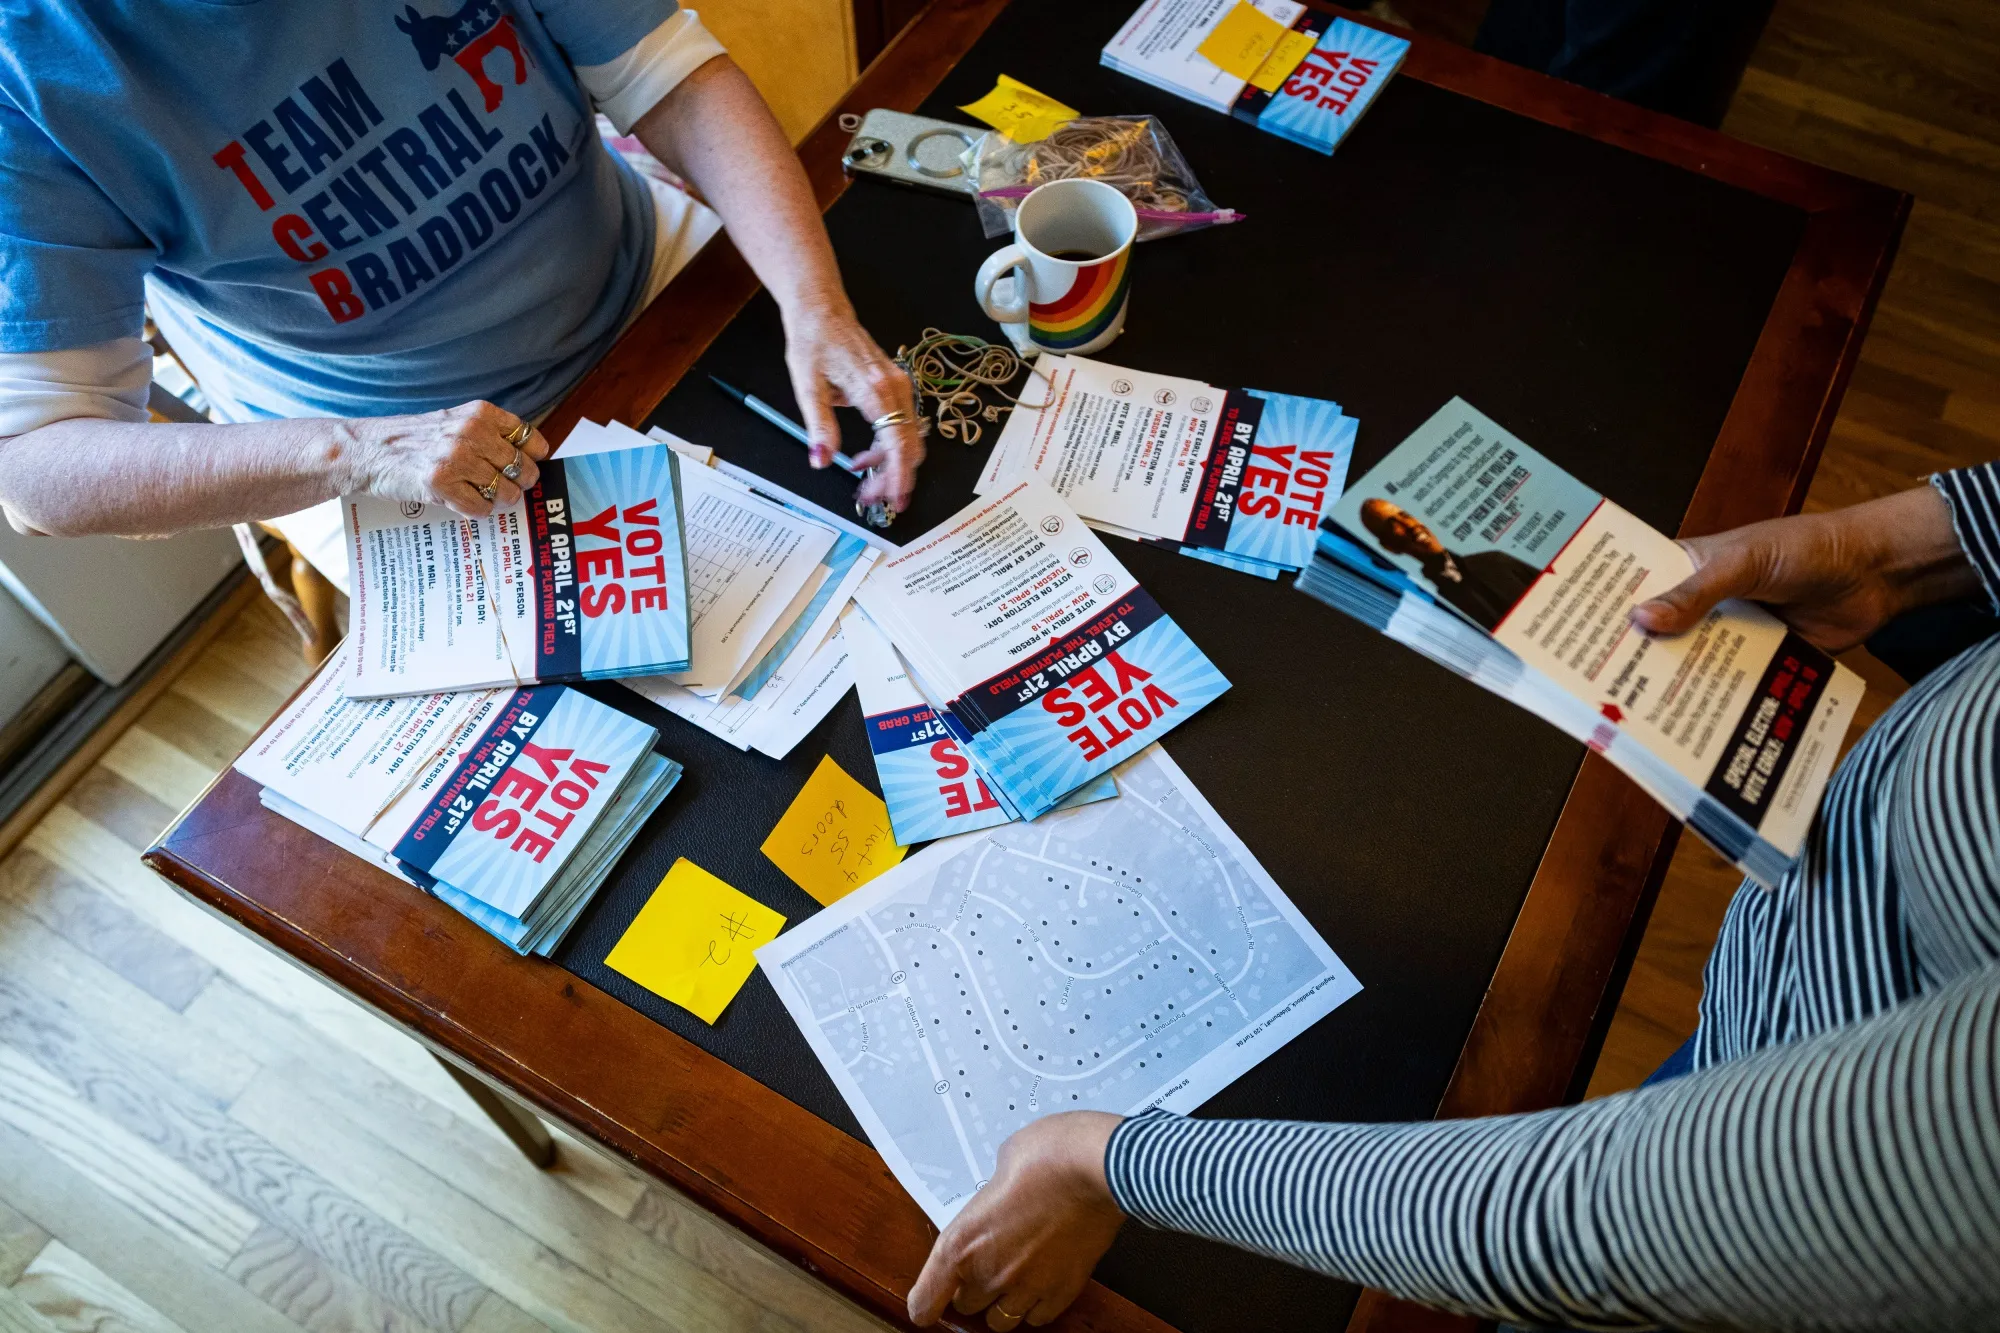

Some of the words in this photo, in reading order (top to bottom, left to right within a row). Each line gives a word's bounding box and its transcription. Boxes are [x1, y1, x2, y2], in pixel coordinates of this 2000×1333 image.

[1283, 48, 1349, 102] YES
[1316, 58, 1379, 116] VOTE
[212, 57, 385, 212] TEAM
[272, 88, 504, 263] CENTRAL
[308, 113, 570, 324] BRADDOCK
[1227, 408, 1238, 418] TO
[1196, 420, 1207, 435] VOTE
[1219, 420, 1235, 446] LEVEL
[1232, 422, 1252, 444] BY
[1190, 438, 1202, 457] EARLY
[1214, 449, 1227, 465] THE
[1220, 446, 1246, 487] APRIL
[532, 482, 542, 498] TO
[1179, 467, 1192, 494] PERSON:
[1202, 467, 1220, 502] PLAYING
[1236, 445, 1296, 518] YES
[1282, 451, 1333, 530] VOTE
[545, 497, 565, 525] BY
[1194, 505, 1209, 529] FIELD
[1213, 492, 1233, 521] 21ST
[470, 518, 479, 539] VOTE
[498, 513, 507, 533] NOW
[508, 511, 518, 535] VOTE
[533, 501, 547, 539] LEVEL
[422, 523, 431, 546] VOTE
[460, 519, 470, 561] TUESDAY,
[425, 549, 433, 561] BY
[502, 545, 510, 571] APRIL
[511, 538, 521, 565] EARLY
[539, 541, 550, 566] THE
[571, 504, 625, 618] YES
[622, 498, 667, 614] VOTE
[1014, 555, 1024, 564] BY
[1024, 541, 1045, 557] VOTE
[514, 569, 522, 578] IN
[550, 532, 572, 593] APRIL
[990, 562, 1013, 578] MAIL:
[427, 565, 435, 589] MAIL:
[464, 564, 473, 589] APRIL
[504, 574, 512, 584] 18
[1029, 565, 1066, 591] TUESDAY,
[1051, 573, 1072, 588] VOTE
[466, 593, 473, 602] 21
[515, 581, 524, 618] PERSON:
[541, 569, 553, 621] PLAYING
[1007, 588, 1030, 605] APRIL
[1039, 585, 1052, 595] ON
[1071, 591, 1089, 605] NOW
[556, 598, 575, 634] 21ST
[997, 602, 1007, 612] 21
[1003, 593, 1040, 619] ELECTION
[1040, 608, 1064, 625] APRIL
[1074, 598, 1096, 614] VOTE
[1116, 602, 1134, 616] TO
[983, 616, 1003, 629] DAY:
[1030, 622, 1041, 631] 18
[1040, 627, 1050, 636] IN
[1051, 612, 1075, 630] EARLY
[1084, 612, 1118, 637] LEVEL
[1103, 620, 1131, 646] BY
[543, 622, 554, 654] FIELD
[1007, 633, 1040, 656] PERSON:
[1062, 635, 1086, 652] THE
[1019, 648, 1064, 678] PLAYING
[1047, 639, 1103, 678] APRIL
[988, 673, 1020, 695] FIELD
[1016, 671, 1050, 701] 21ST
[1043, 650, 1152, 724] YES
[516, 691, 533, 706] TO
[491, 706, 521, 739] LEVEL
[510, 711, 538, 740] BY
[878, 715, 910, 730] GRAB
[1066, 683, 1178, 762] VOTE
[473, 740, 496, 762] THE
[465, 739, 517, 792] APRIL
[437, 762, 478, 808] PLAYING
[474, 741, 574, 838] YES
[939, 777, 1000, 818] TE
[442, 794, 474, 834] 21ST
[509, 759, 610, 863] VOTE
[412, 808, 442, 841] FIELD
[801, 800, 847, 855] doors
[1181, 825, 1192, 835] Rd
[1189, 830, 1217, 859] Portsmouth
[904, 923, 942, 933] Portsmouth
[1237, 906, 1252, 941] Portsmouth
[1248, 940, 1255, 950] Rd
[1144, 939, 1160, 951] Briar
[1228, 992, 1237, 1001] Dr
[904, 996, 921, 1029] Sideburn
[917, 1027, 926, 1039] Rd
[1155, 1011, 1186, 1034] Portsmouth
[1145, 1030, 1155, 1040] Rd
[1163, 1083, 1183, 1098] People
